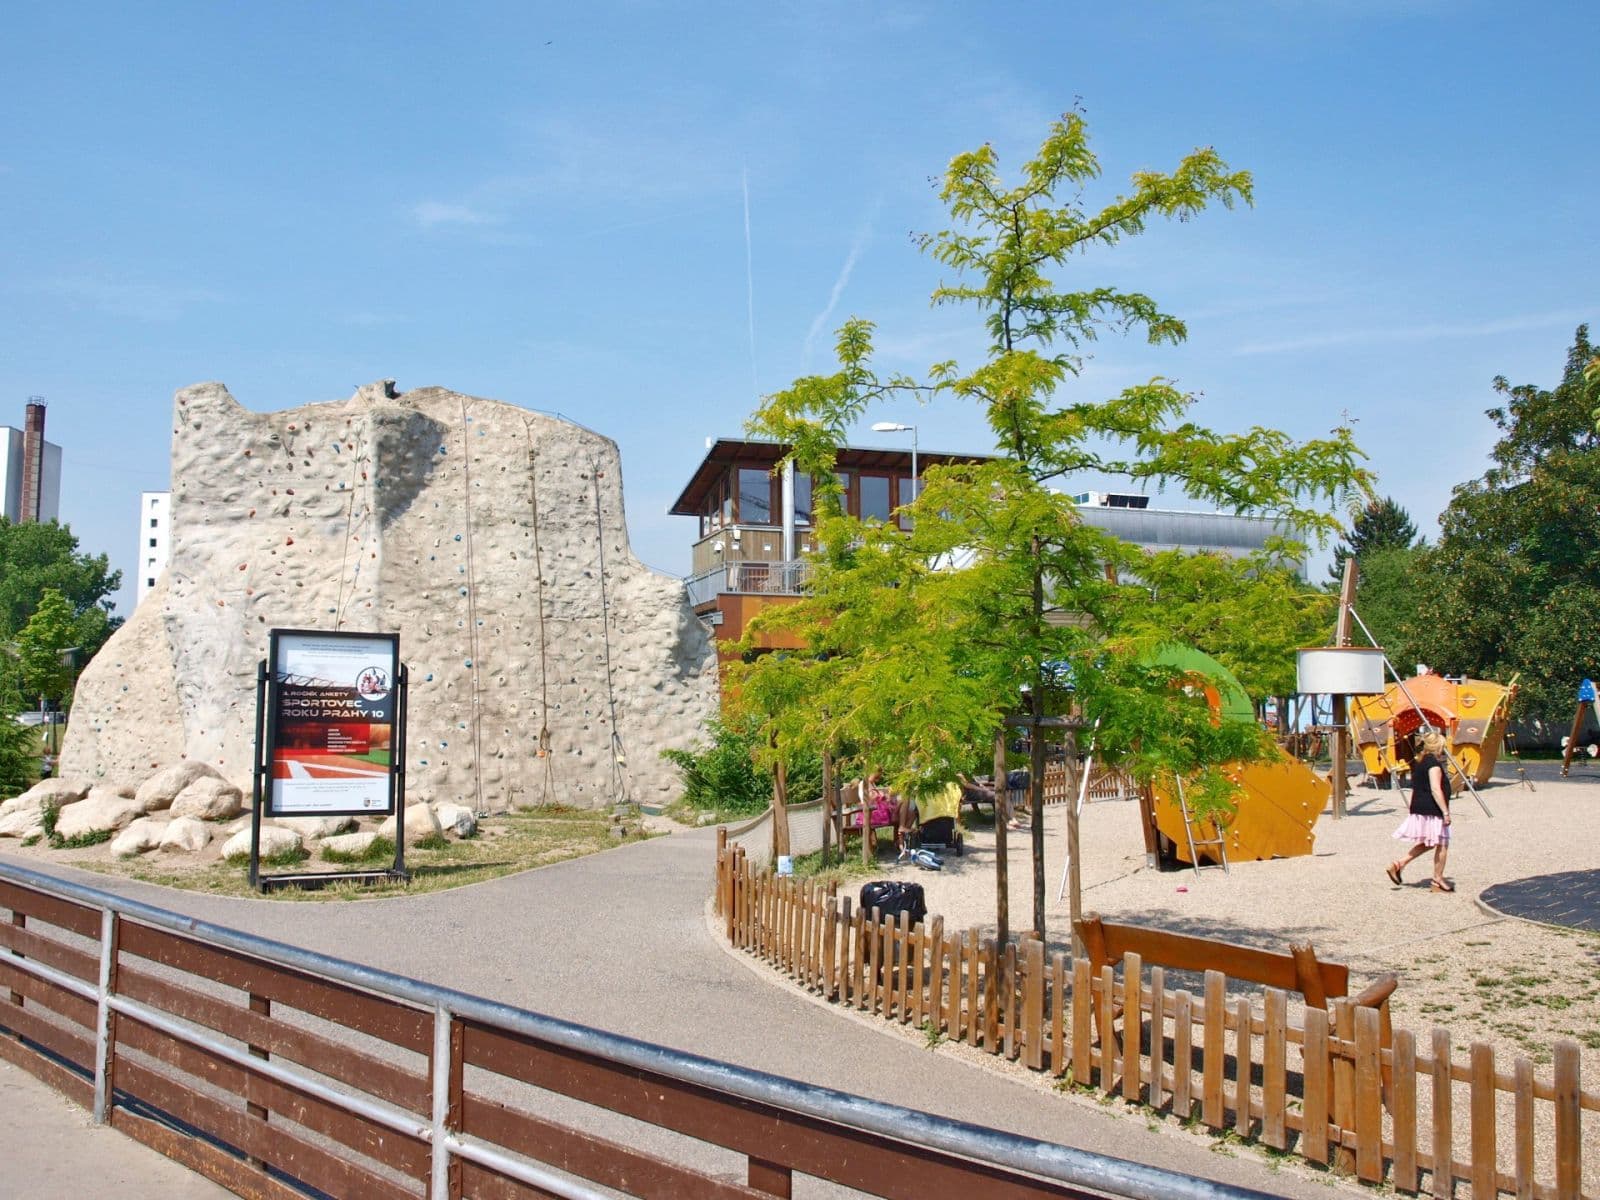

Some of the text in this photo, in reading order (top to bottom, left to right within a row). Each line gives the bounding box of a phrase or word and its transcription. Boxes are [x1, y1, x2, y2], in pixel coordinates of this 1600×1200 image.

[282, 699, 362, 707] SPORTOVEC
[282, 709, 319, 717] ROKU
[322, 710, 367, 718] PRAHY
